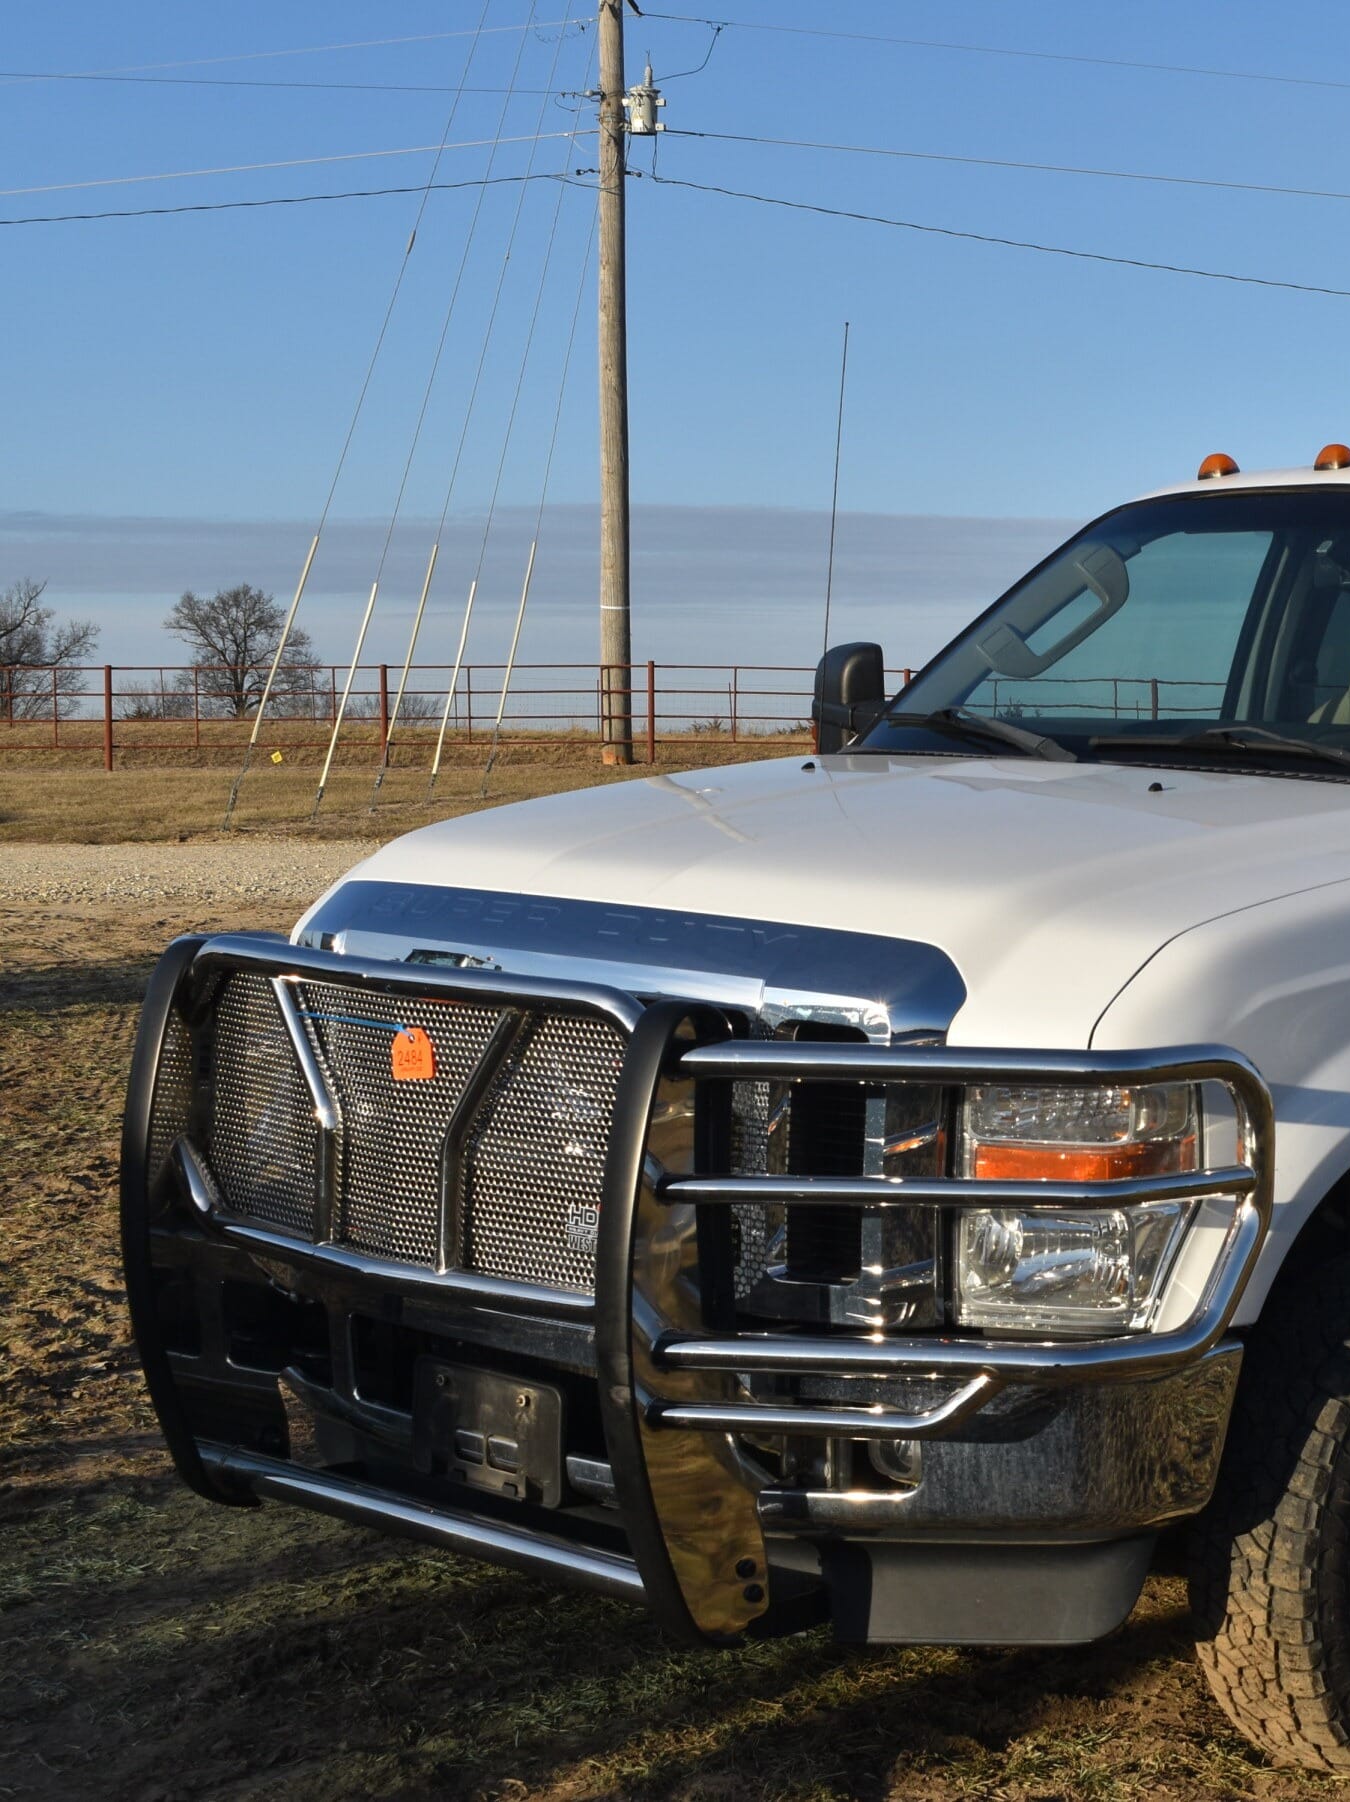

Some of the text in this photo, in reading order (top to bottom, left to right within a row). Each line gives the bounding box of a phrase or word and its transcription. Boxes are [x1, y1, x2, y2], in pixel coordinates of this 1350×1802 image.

[373, 890, 799, 952] SUPER DUTY
[397, 1050, 423, 1066] 2484
[569, 1201, 602, 1228] HD
[569, 1235, 598, 1253] WEST
